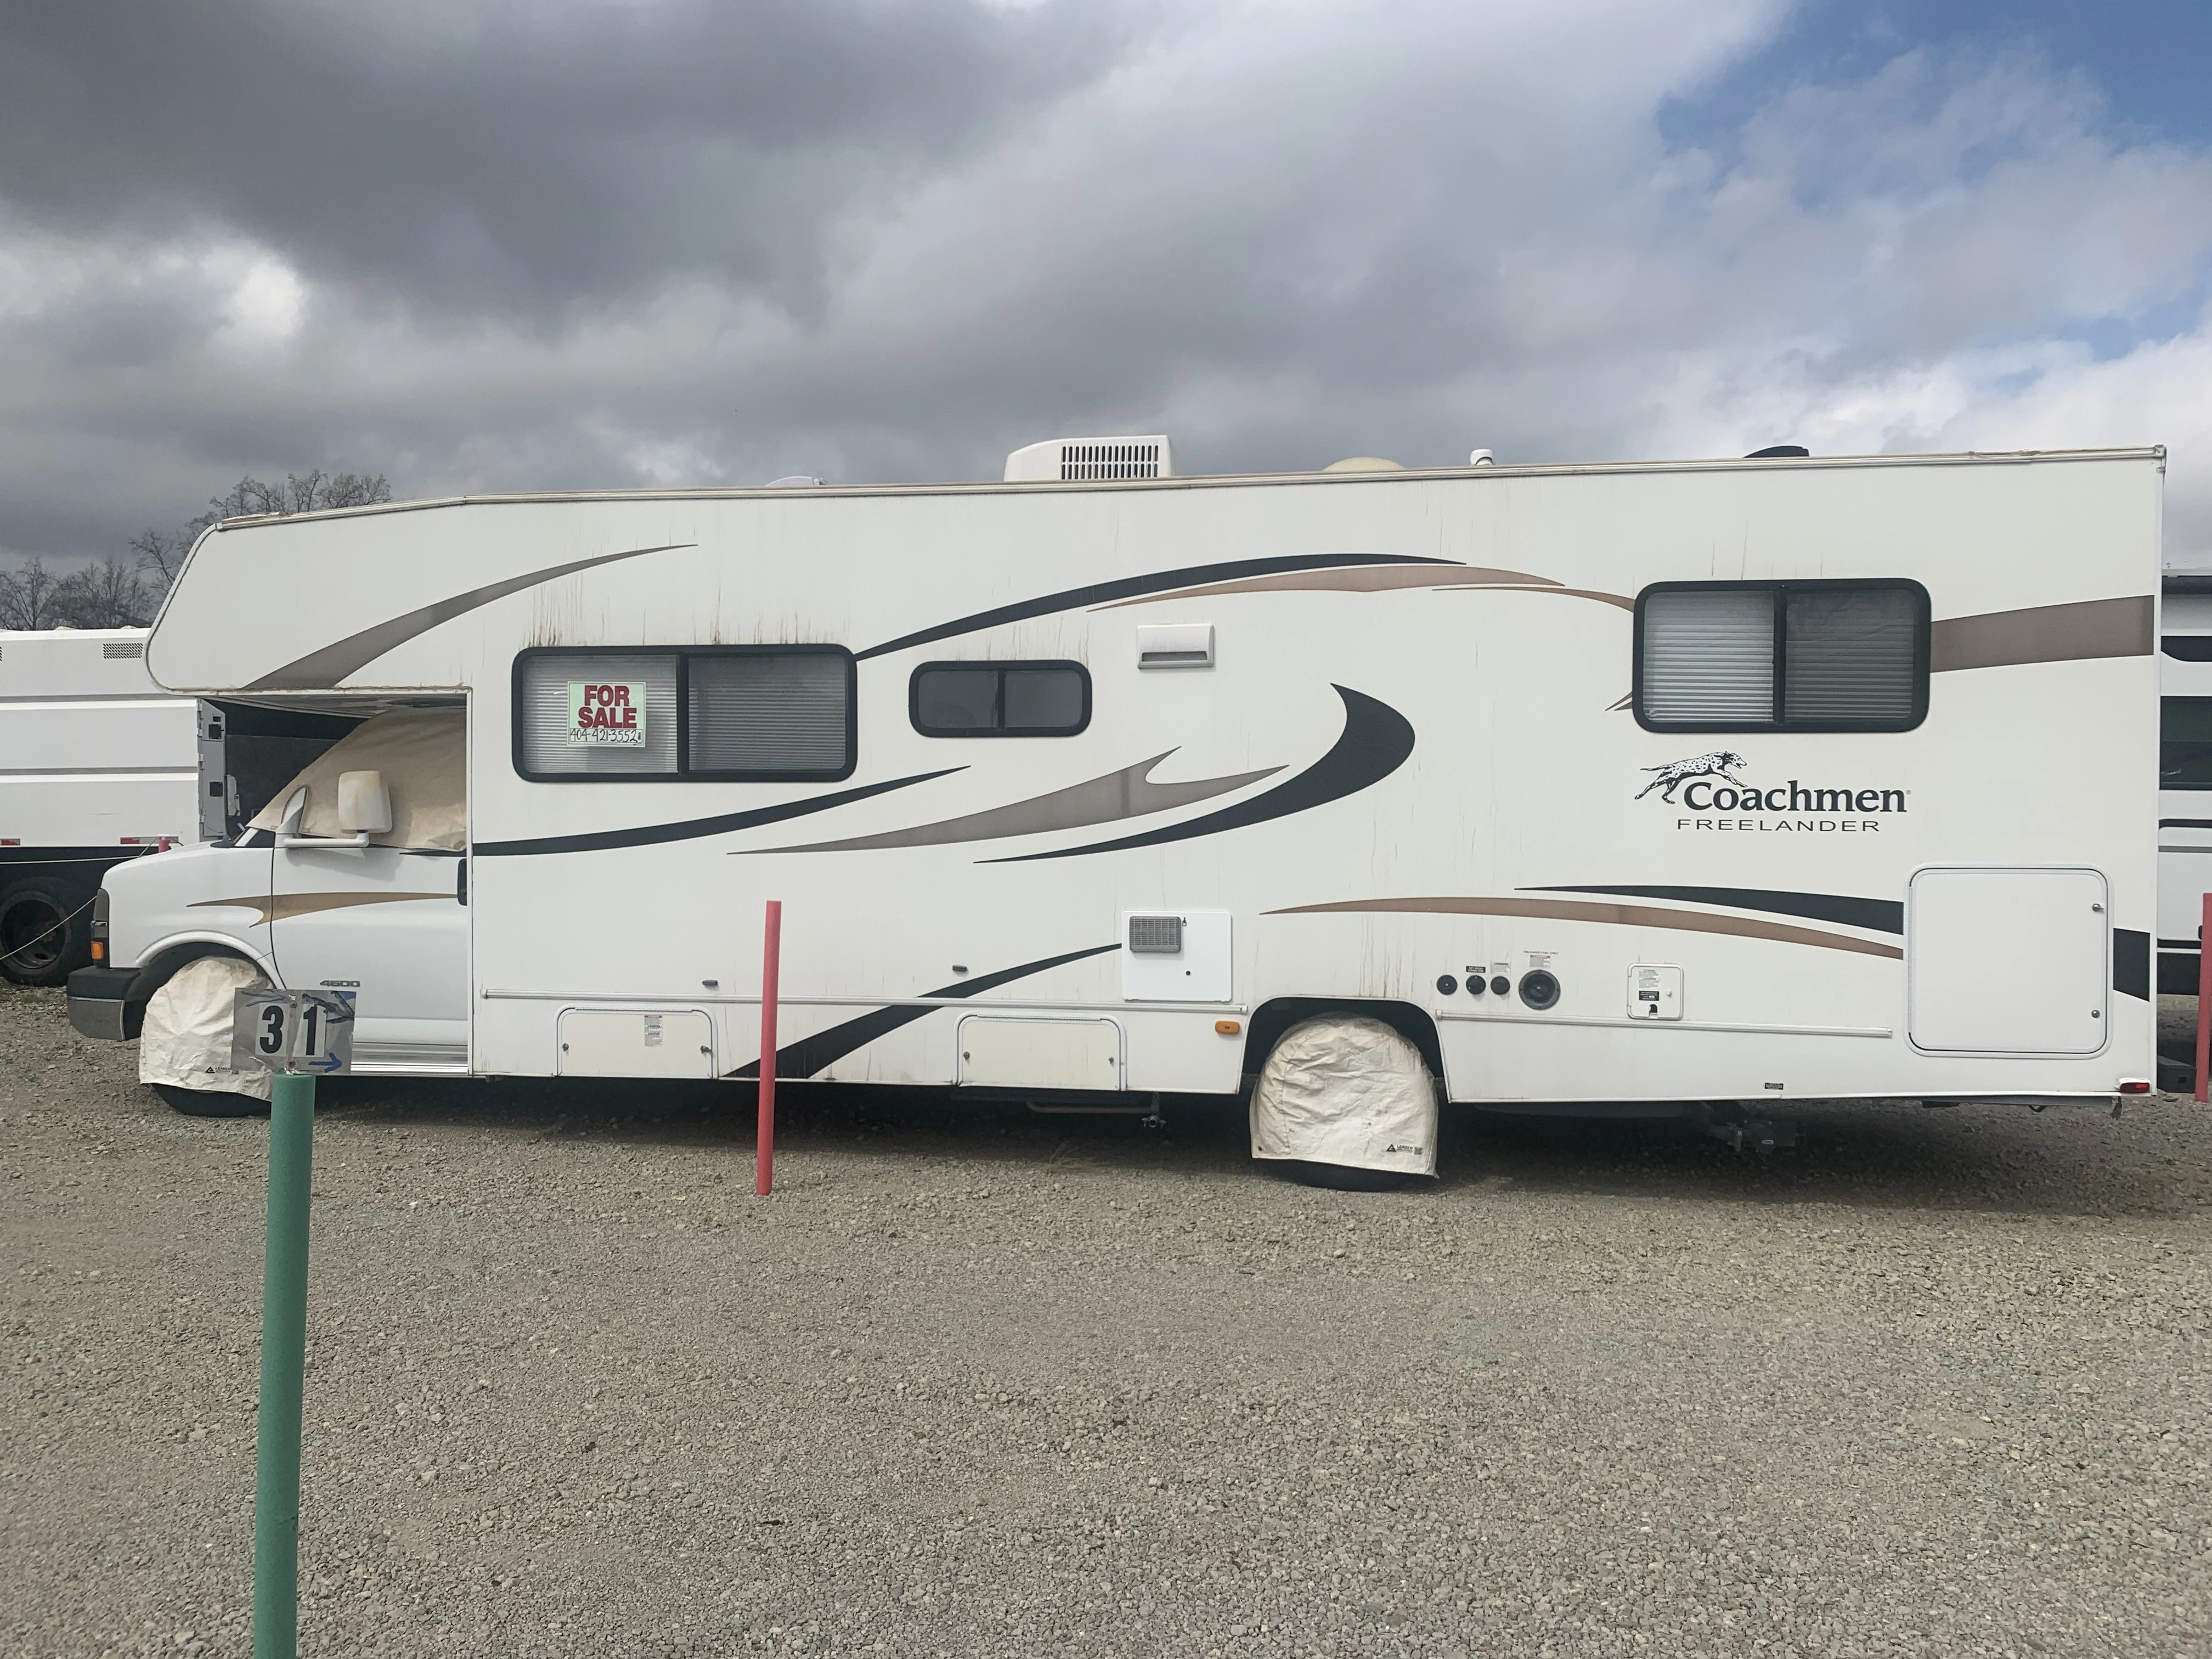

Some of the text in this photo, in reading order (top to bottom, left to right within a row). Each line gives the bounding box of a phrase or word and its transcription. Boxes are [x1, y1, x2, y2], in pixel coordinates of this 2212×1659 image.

[584, 685, 630, 707] FOR
[578, 707, 637, 729] SALE
[570, 728, 638, 743] 404-421-3552
[1684, 780, 1908, 813] Coachmen
[1677, 819, 1880, 832] FREELANDER
